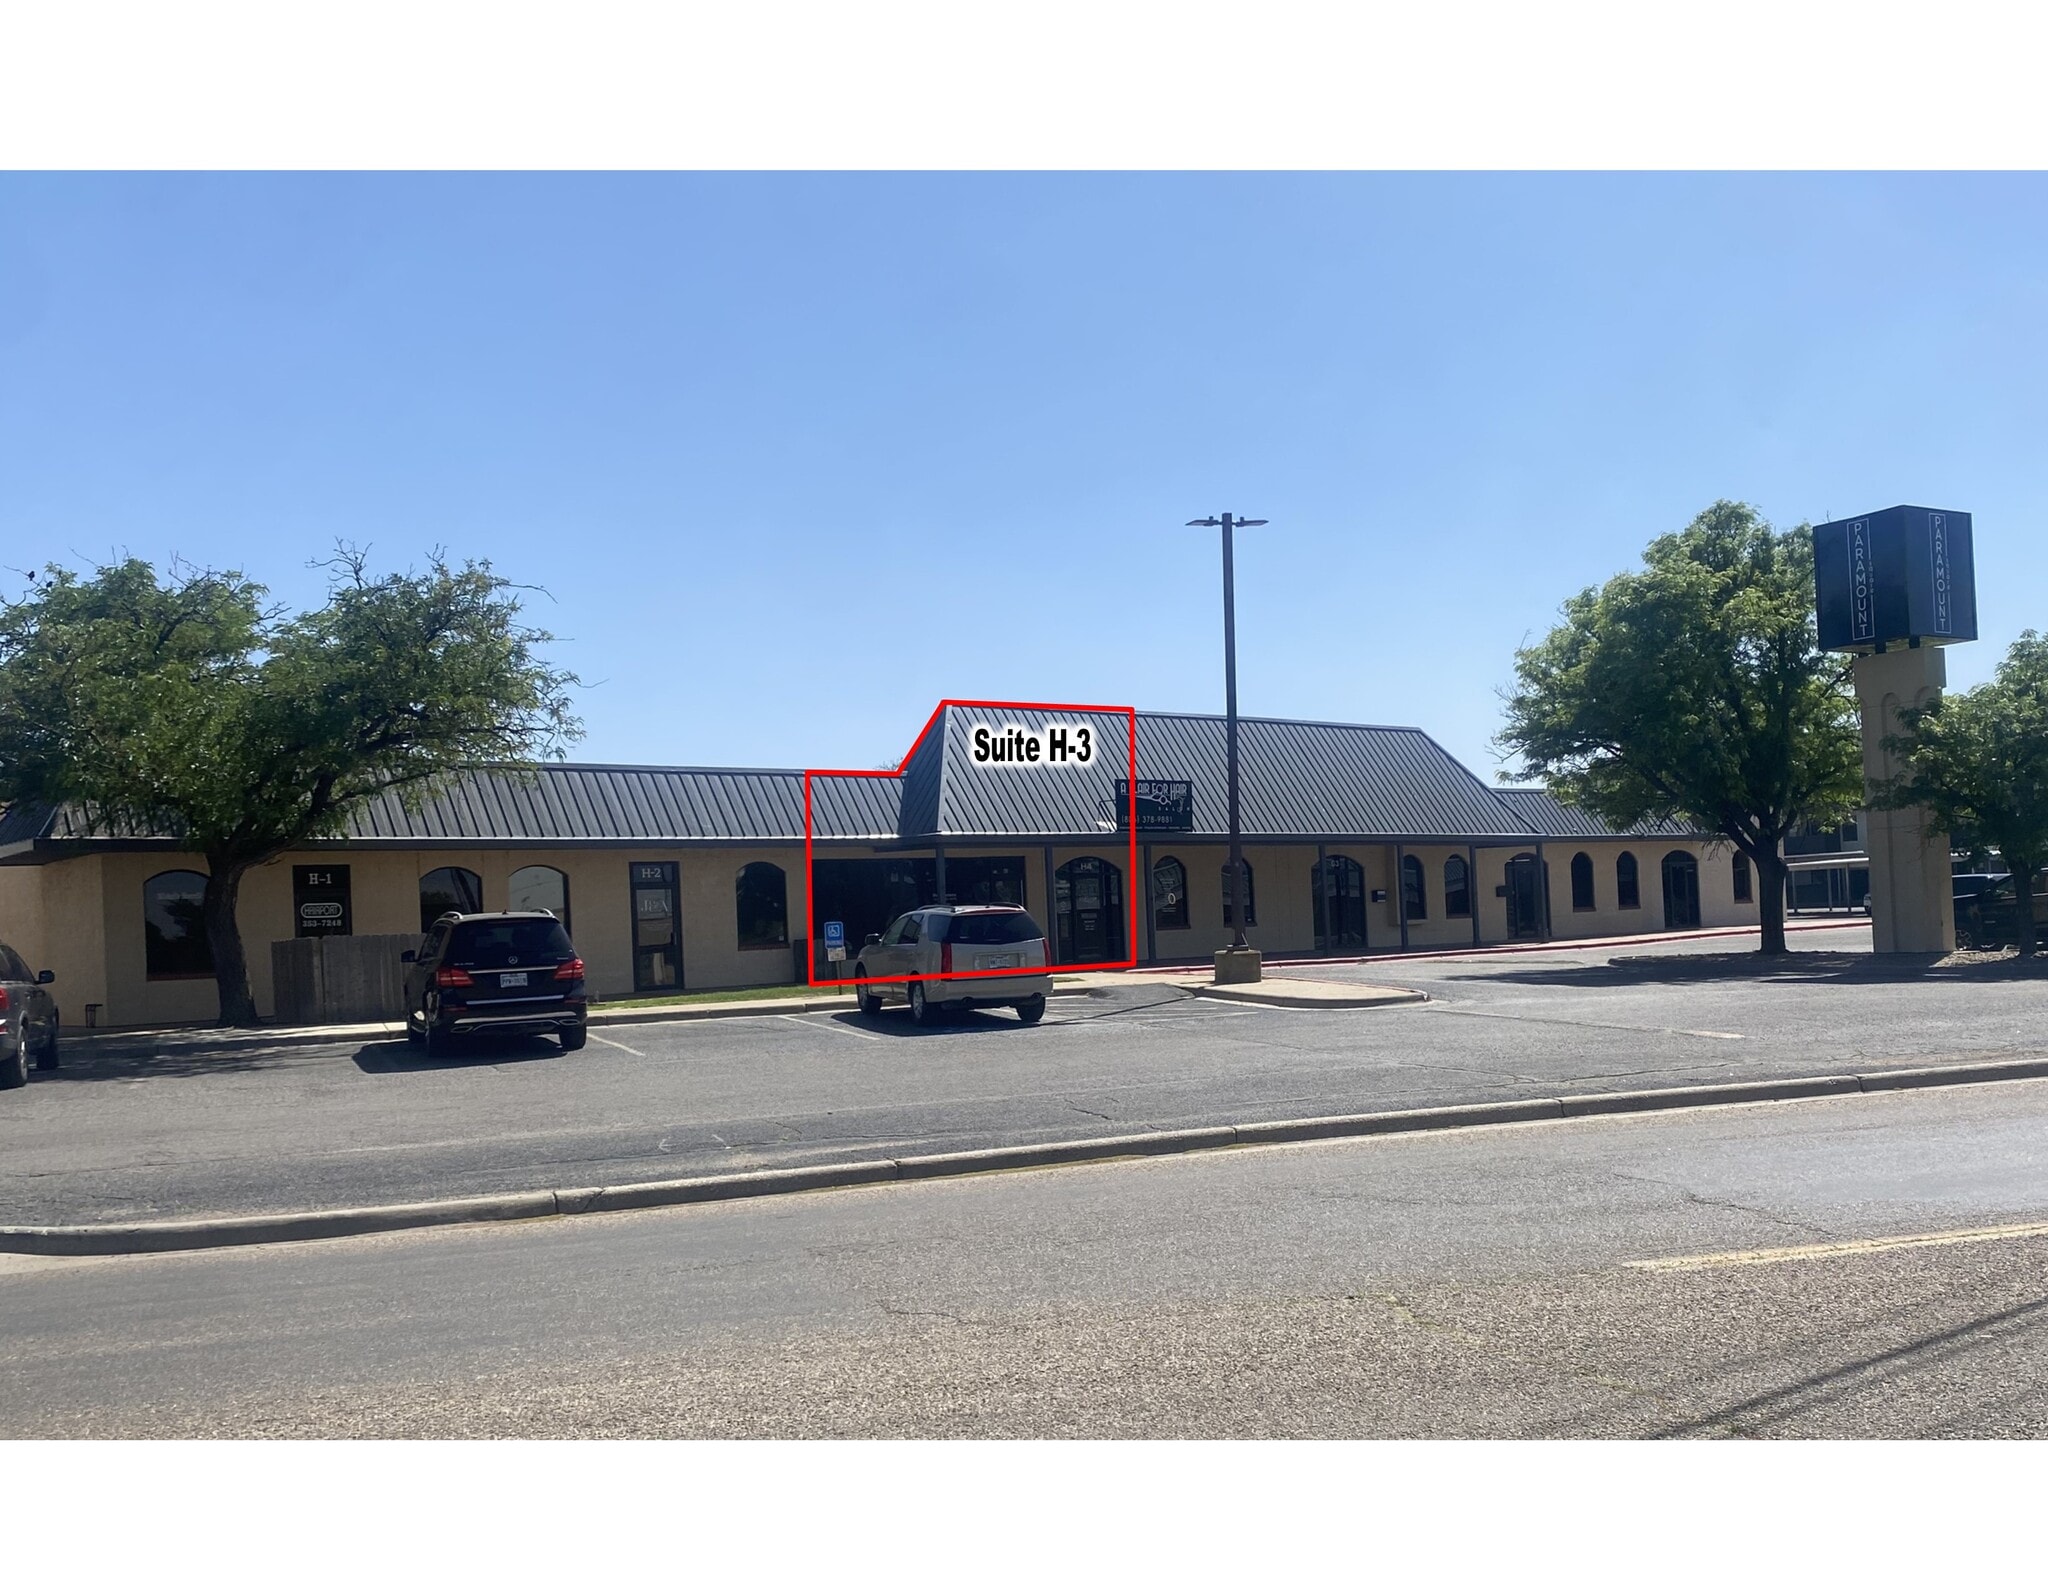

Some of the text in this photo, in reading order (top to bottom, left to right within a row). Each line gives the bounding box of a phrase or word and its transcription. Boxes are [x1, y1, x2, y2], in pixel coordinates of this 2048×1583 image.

[1854, 523, 1868, 636] PARAMOUNT
[1935, 516, 1946, 630] PARAMOUNT
[1120, 783, 1126, 794] A
[1152, 783, 1168, 795] FOR
[1170, 783, 1187, 800] HAIR
[309, 873, 331, 884] H-1
[642, 868, 661, 878] H-2
